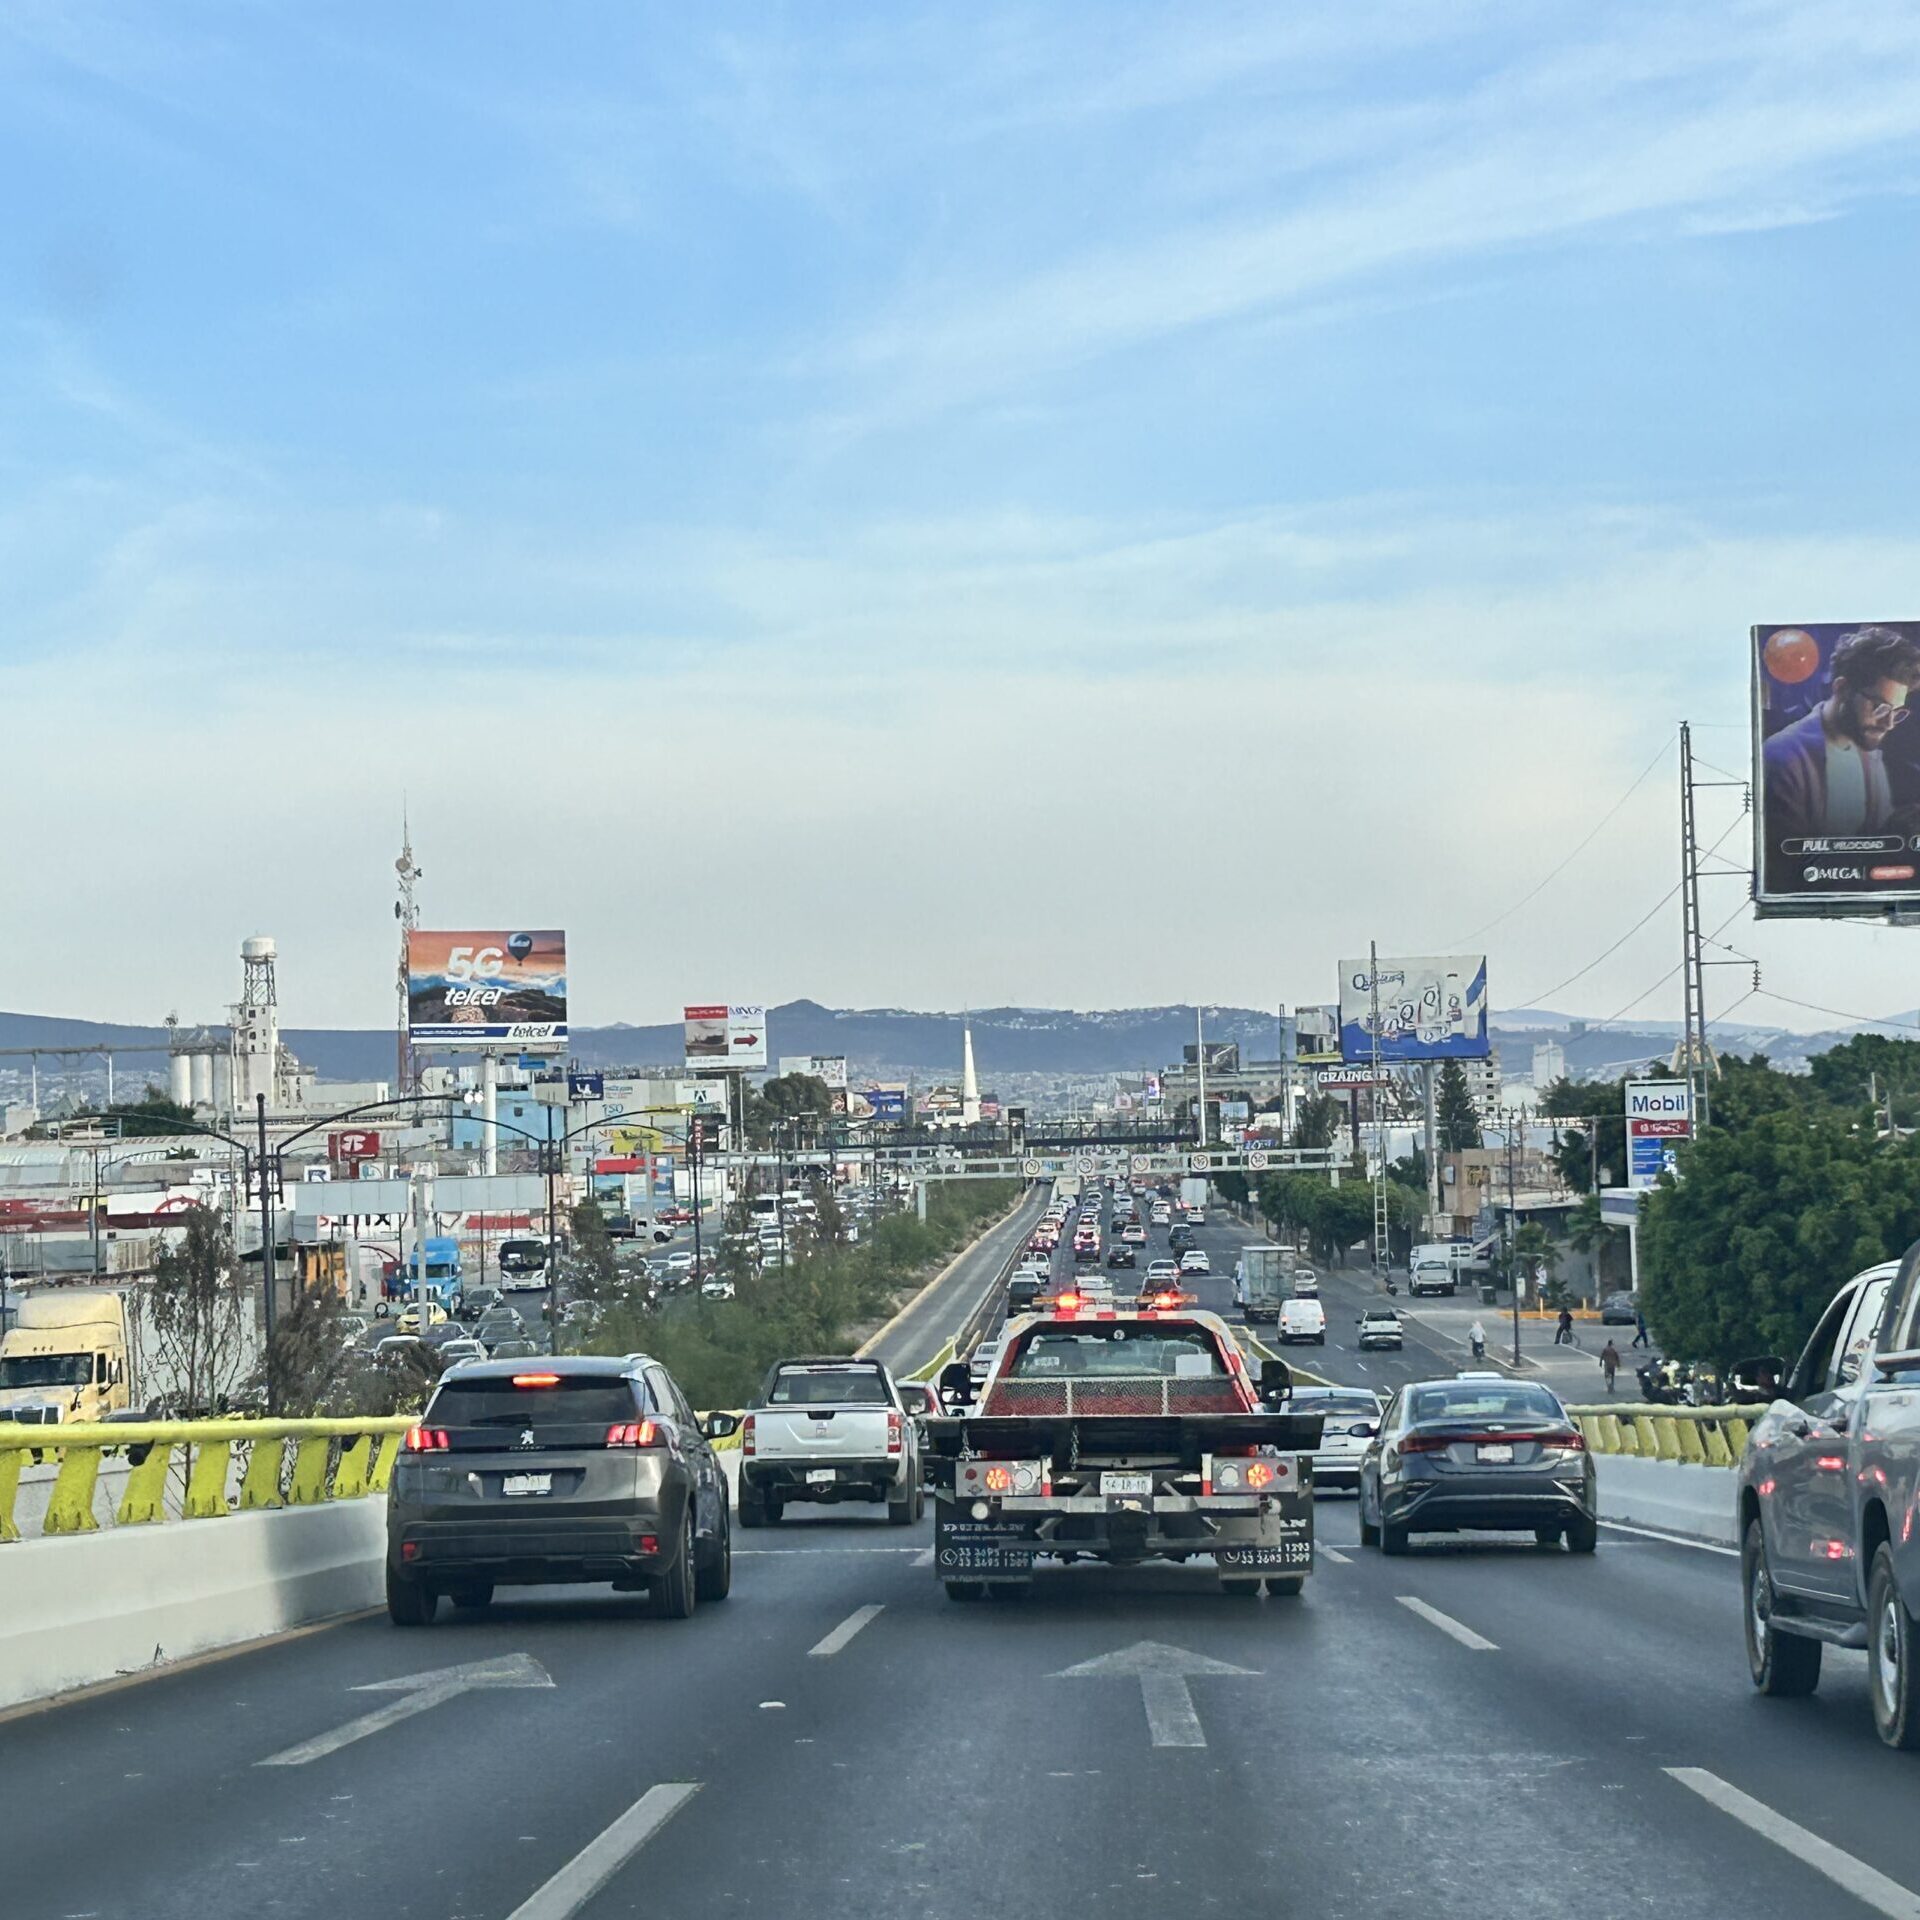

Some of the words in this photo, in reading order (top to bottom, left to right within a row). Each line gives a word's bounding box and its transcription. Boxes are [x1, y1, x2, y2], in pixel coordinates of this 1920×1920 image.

[445, 947, 503, 982] 5G
[444, 987, 503, 1005] telcel
[512, 1025, 550, 1037] telcel
[1318, 1069, 1390, 1084] GRAINGR
[1632, 1095, 1685, 1112] Mobil
